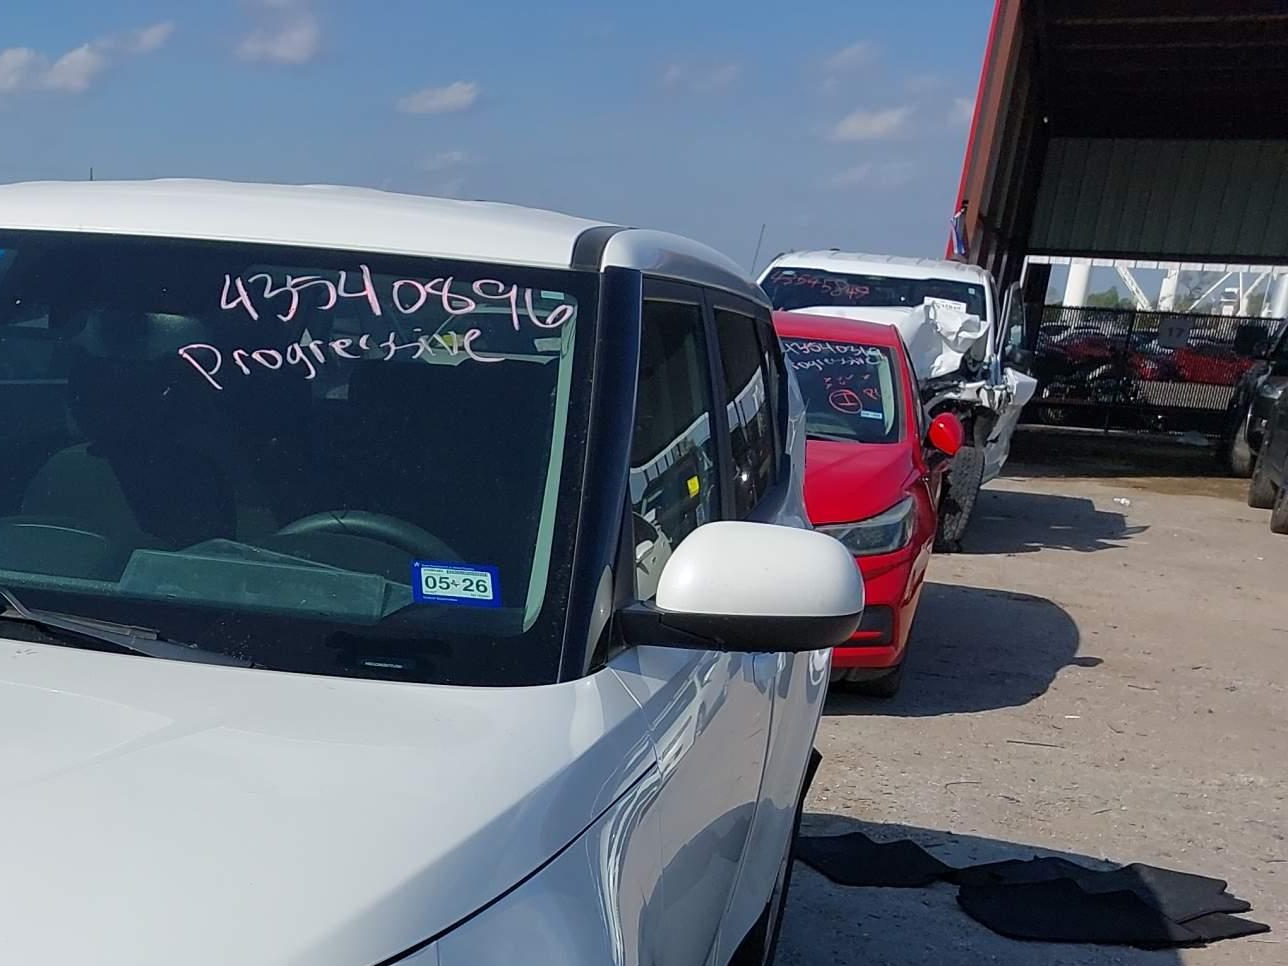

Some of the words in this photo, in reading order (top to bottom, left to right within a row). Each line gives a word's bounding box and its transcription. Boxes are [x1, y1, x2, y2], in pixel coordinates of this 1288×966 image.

[220, 264, 574, 331] 43540896
[1167, 326, 1185, 339] 17
[424, 575, 451, 590] 05
[462, 578, 488, 593] 26
